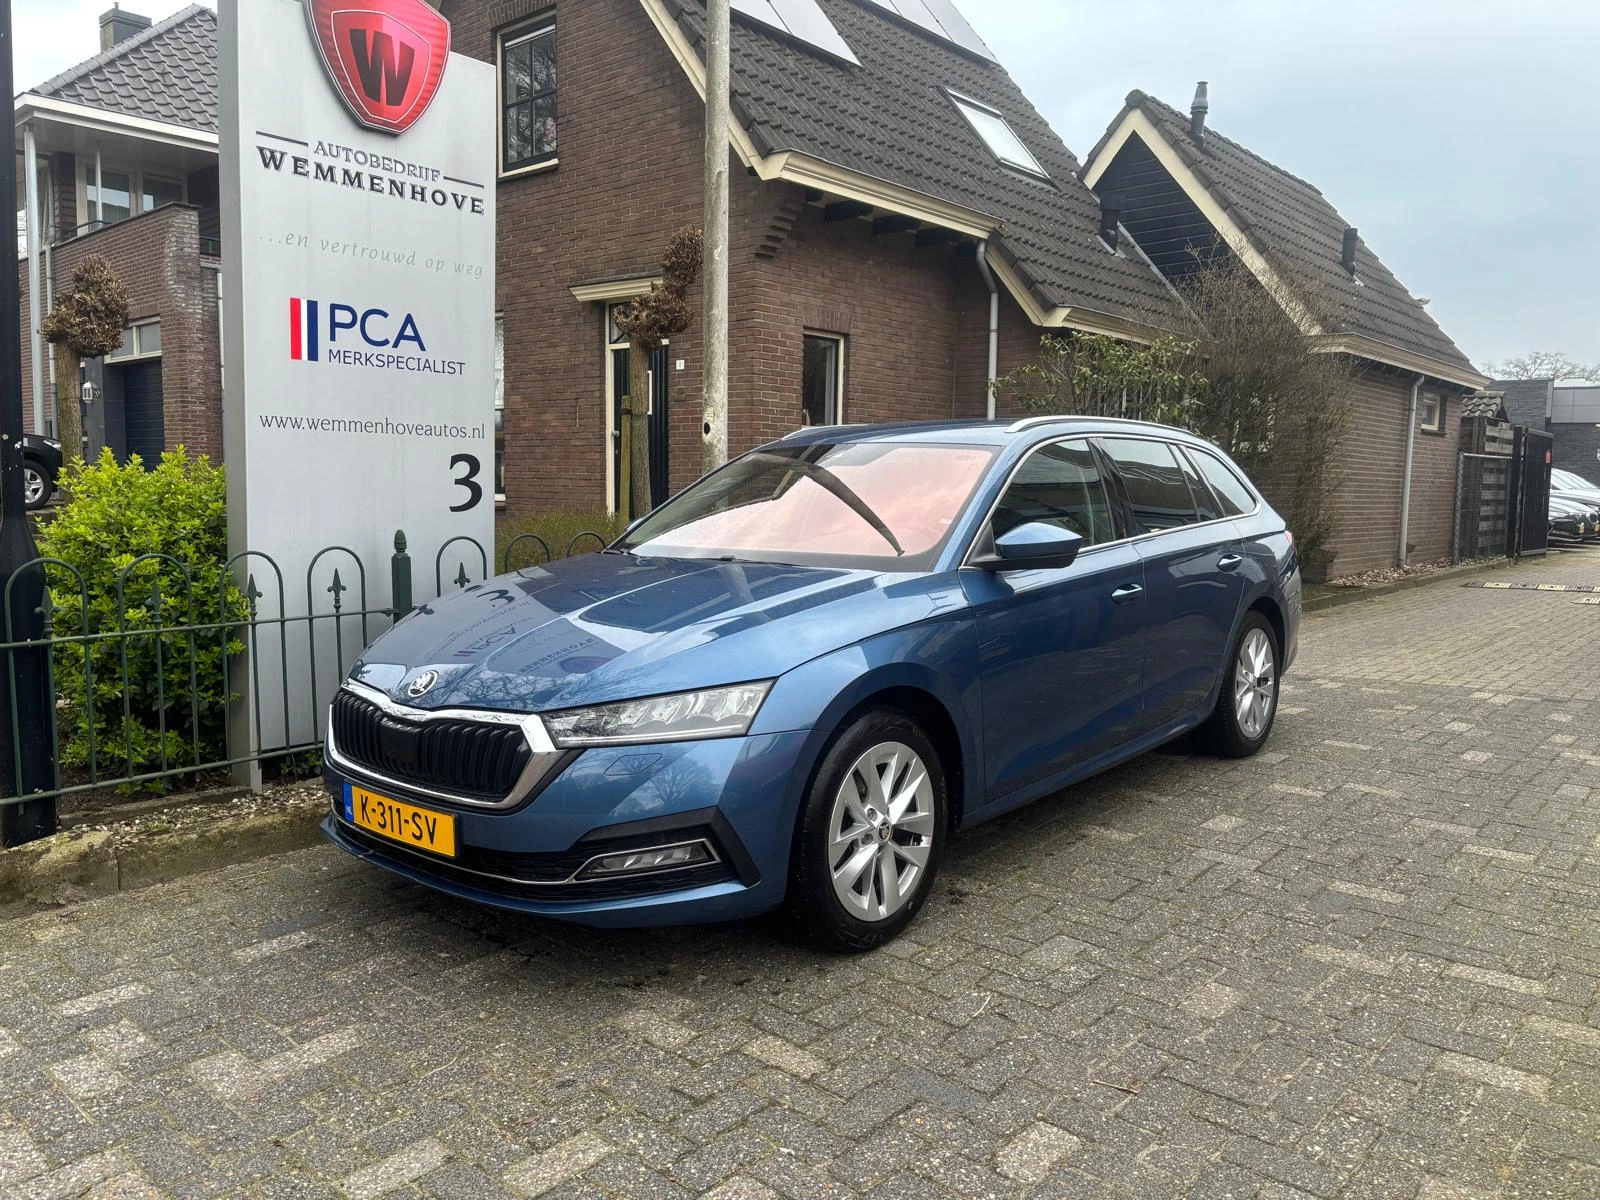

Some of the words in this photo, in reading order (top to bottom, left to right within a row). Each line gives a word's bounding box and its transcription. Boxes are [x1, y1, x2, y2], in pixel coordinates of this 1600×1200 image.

[349, 28, 415, 107] W
[256, 145, 485, 216] WEMMENHOVE
[313, 140, 442, 183] AUTOBEDRIJF
[320, 237, 417, 267] vertrouwd
[424, 256, 445, 273] op
[453, 260, 484, 280] weg
[329, 303, 427, 352] PCA
[328, 348, 466, 376] MERKSPECIALIST
[259, 414, 485, 440] www.wemmenhoveautos.nl
[448, 453, 483, 513] 3
[360, 793, 437, 846] K-311-SV
